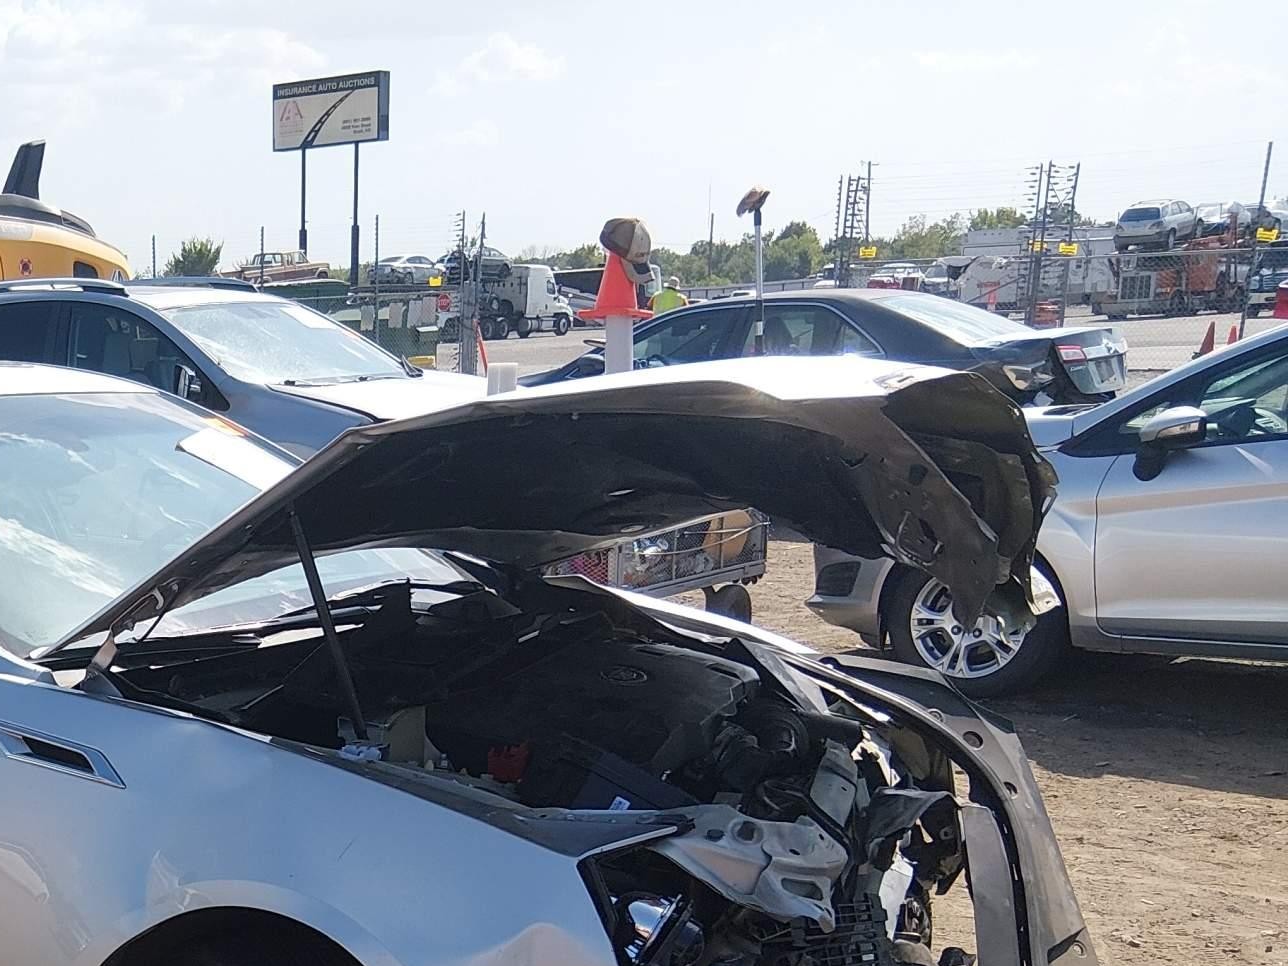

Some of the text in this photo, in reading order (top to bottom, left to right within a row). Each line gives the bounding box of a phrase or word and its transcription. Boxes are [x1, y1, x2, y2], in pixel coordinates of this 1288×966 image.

[277, 77, 375, 97] INSURANCE AUTO AUCTIONS
